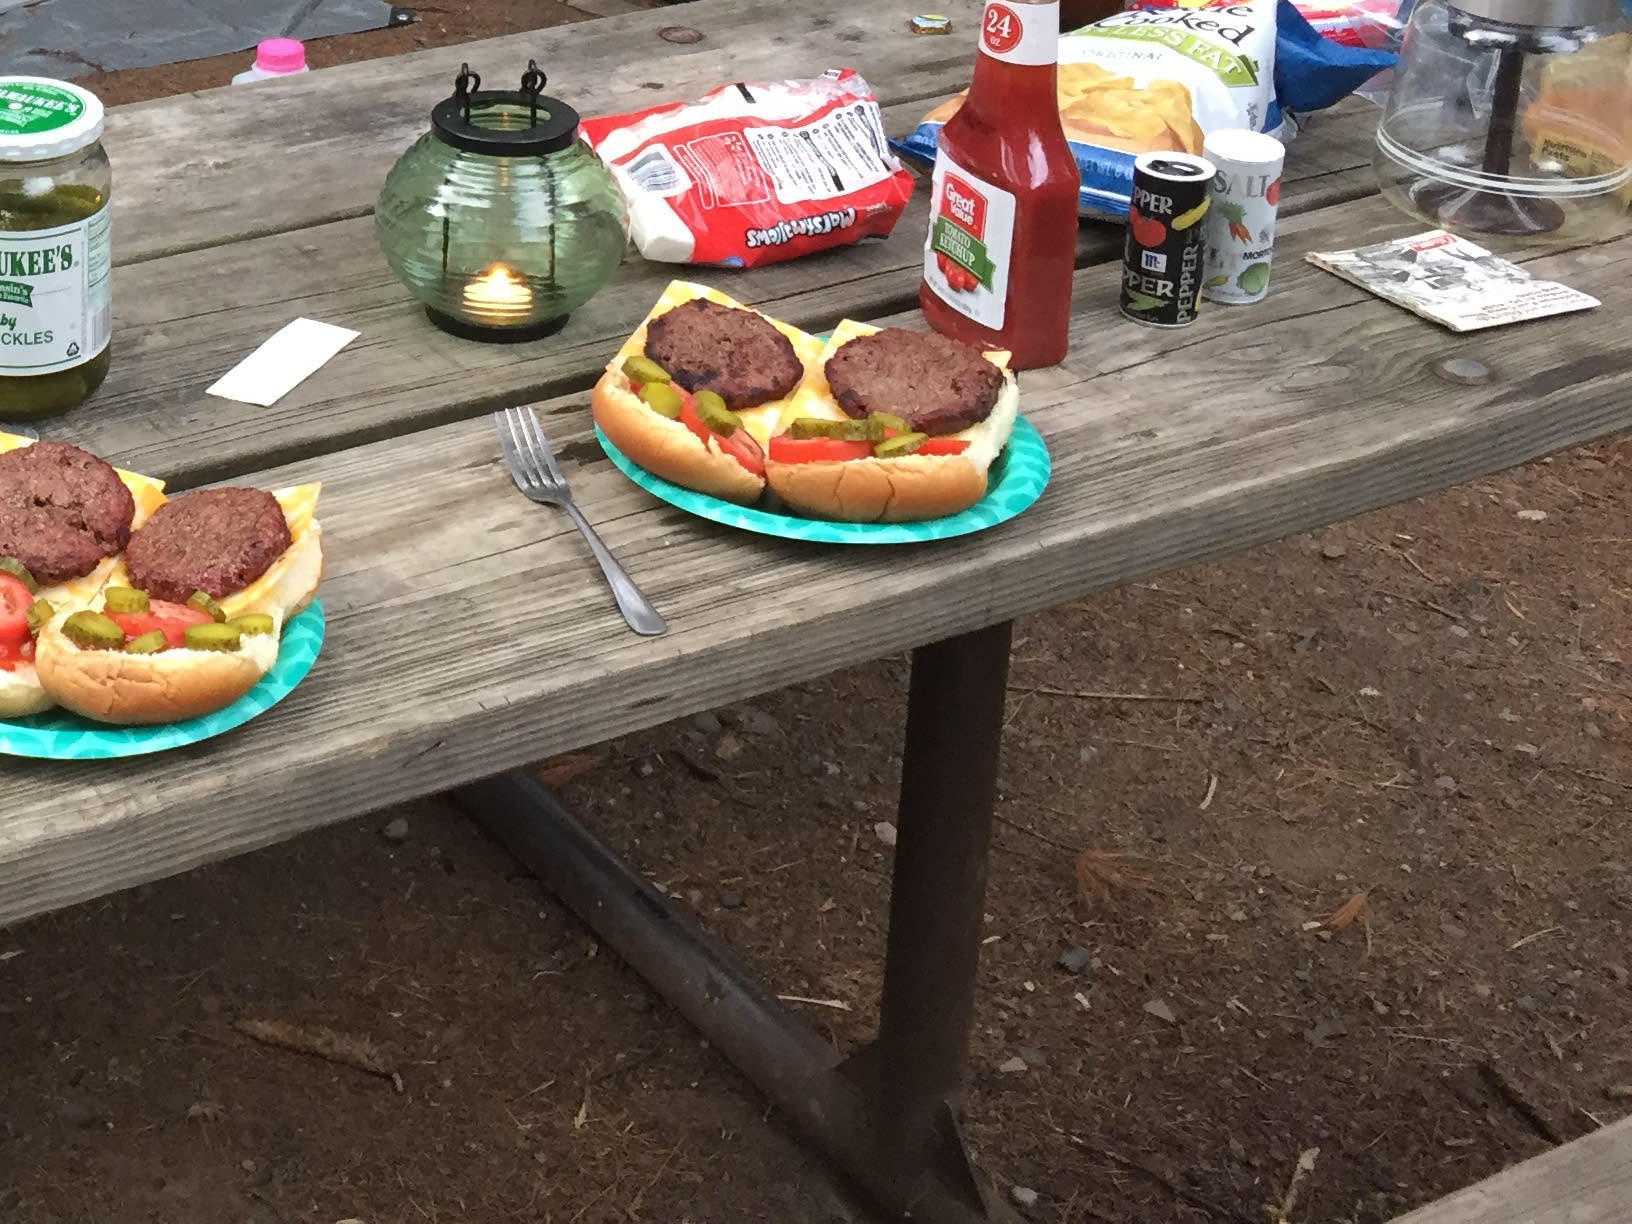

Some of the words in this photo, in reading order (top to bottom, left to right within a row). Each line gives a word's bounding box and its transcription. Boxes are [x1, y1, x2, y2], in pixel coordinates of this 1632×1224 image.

[986, 8, 1012, 38] 24
[1093, 11, 1255, 47] Cooked
[1113, 26, 1187, 47] LESS
[1186, 37, 1242, 75] FAT
[946, 182, 975, 216] Great
[950, 200, 974, 226] Value
[939, 233, 976, 267] KETCHUP
[944, 222, 971, 249] TOMATO
[1177, 243, 1199, 323] PEPPER
